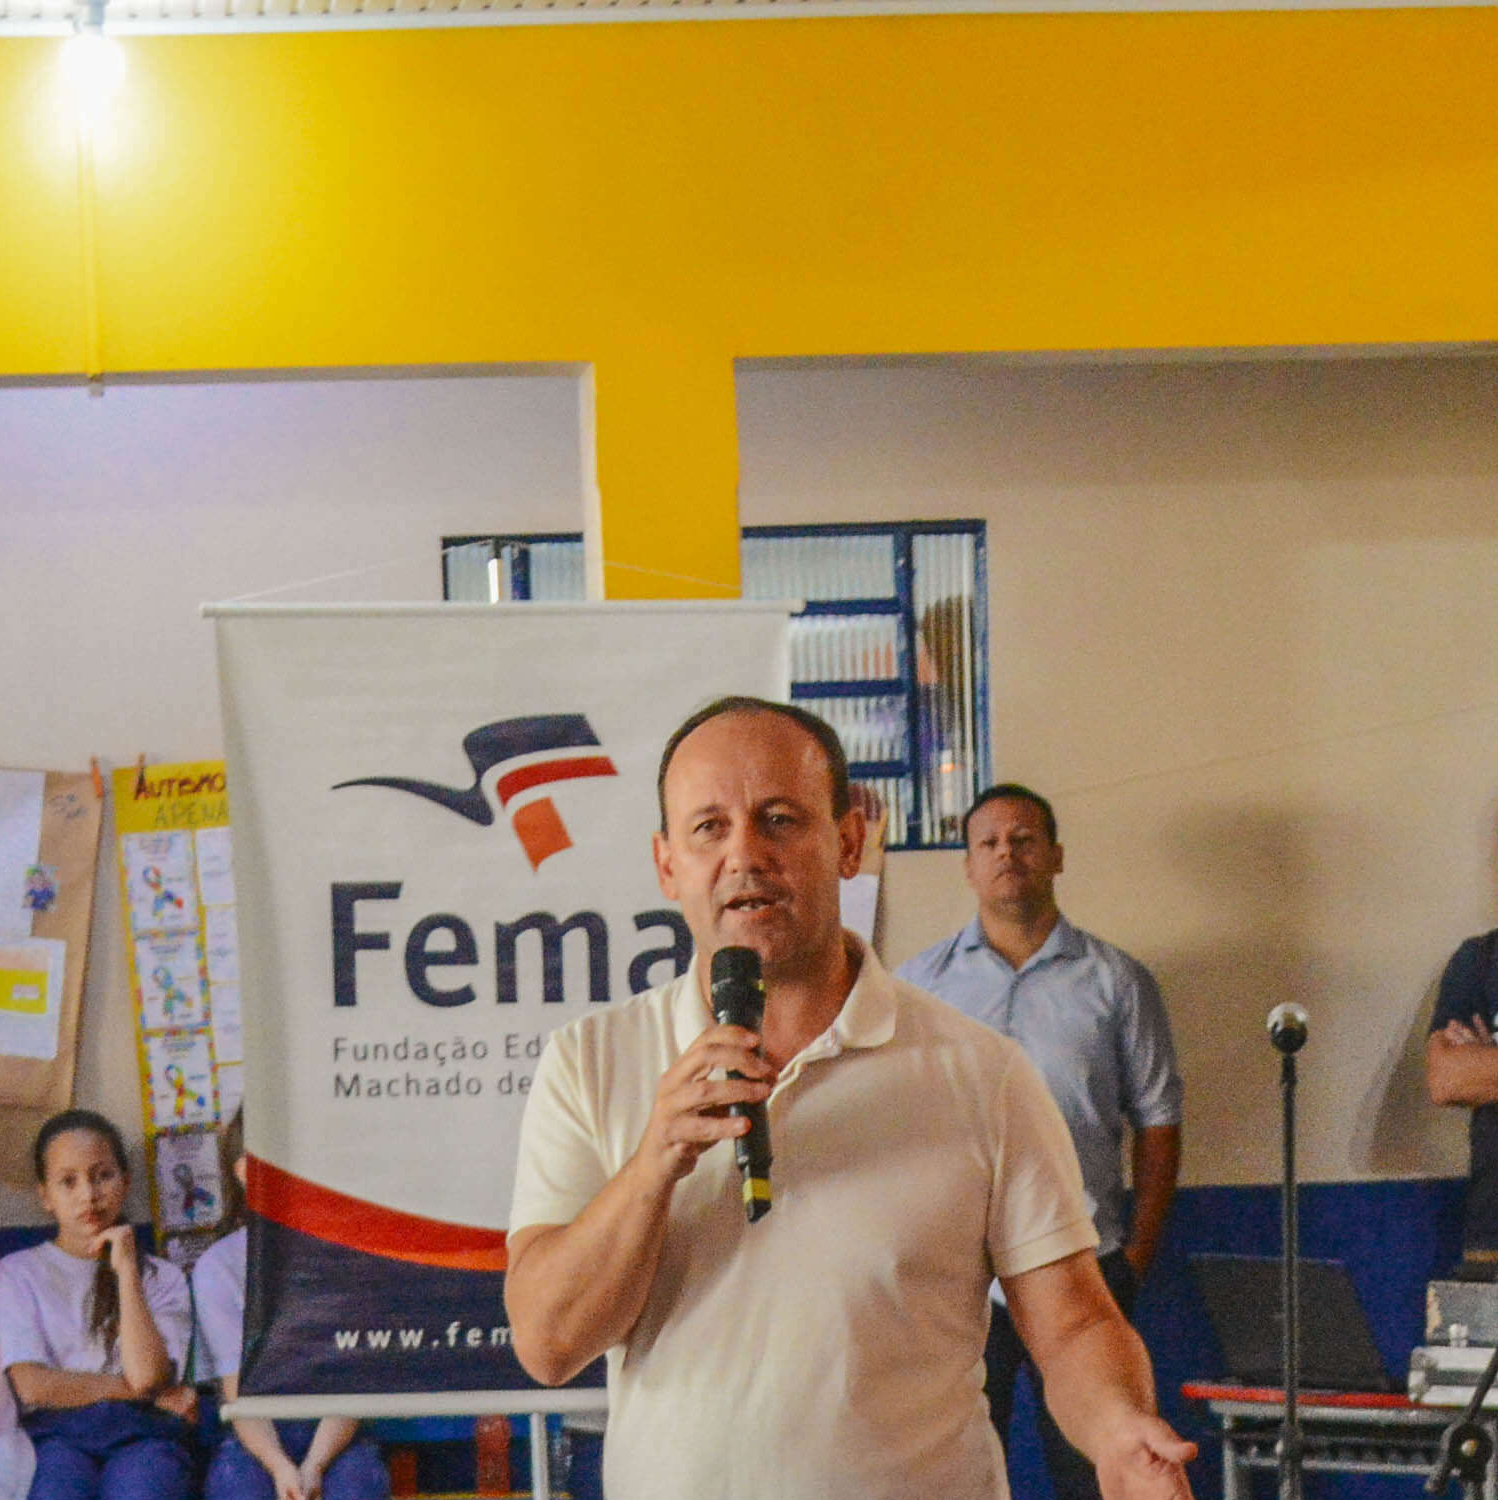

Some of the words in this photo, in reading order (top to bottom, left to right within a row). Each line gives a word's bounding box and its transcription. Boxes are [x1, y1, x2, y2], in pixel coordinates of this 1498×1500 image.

[331, 880, 694, 1008] Fema
[333, 1034, 488, 1066] Fundação
[333, 1072, 482, 1097] Machado
[498, 1071, 532, 1096] de
